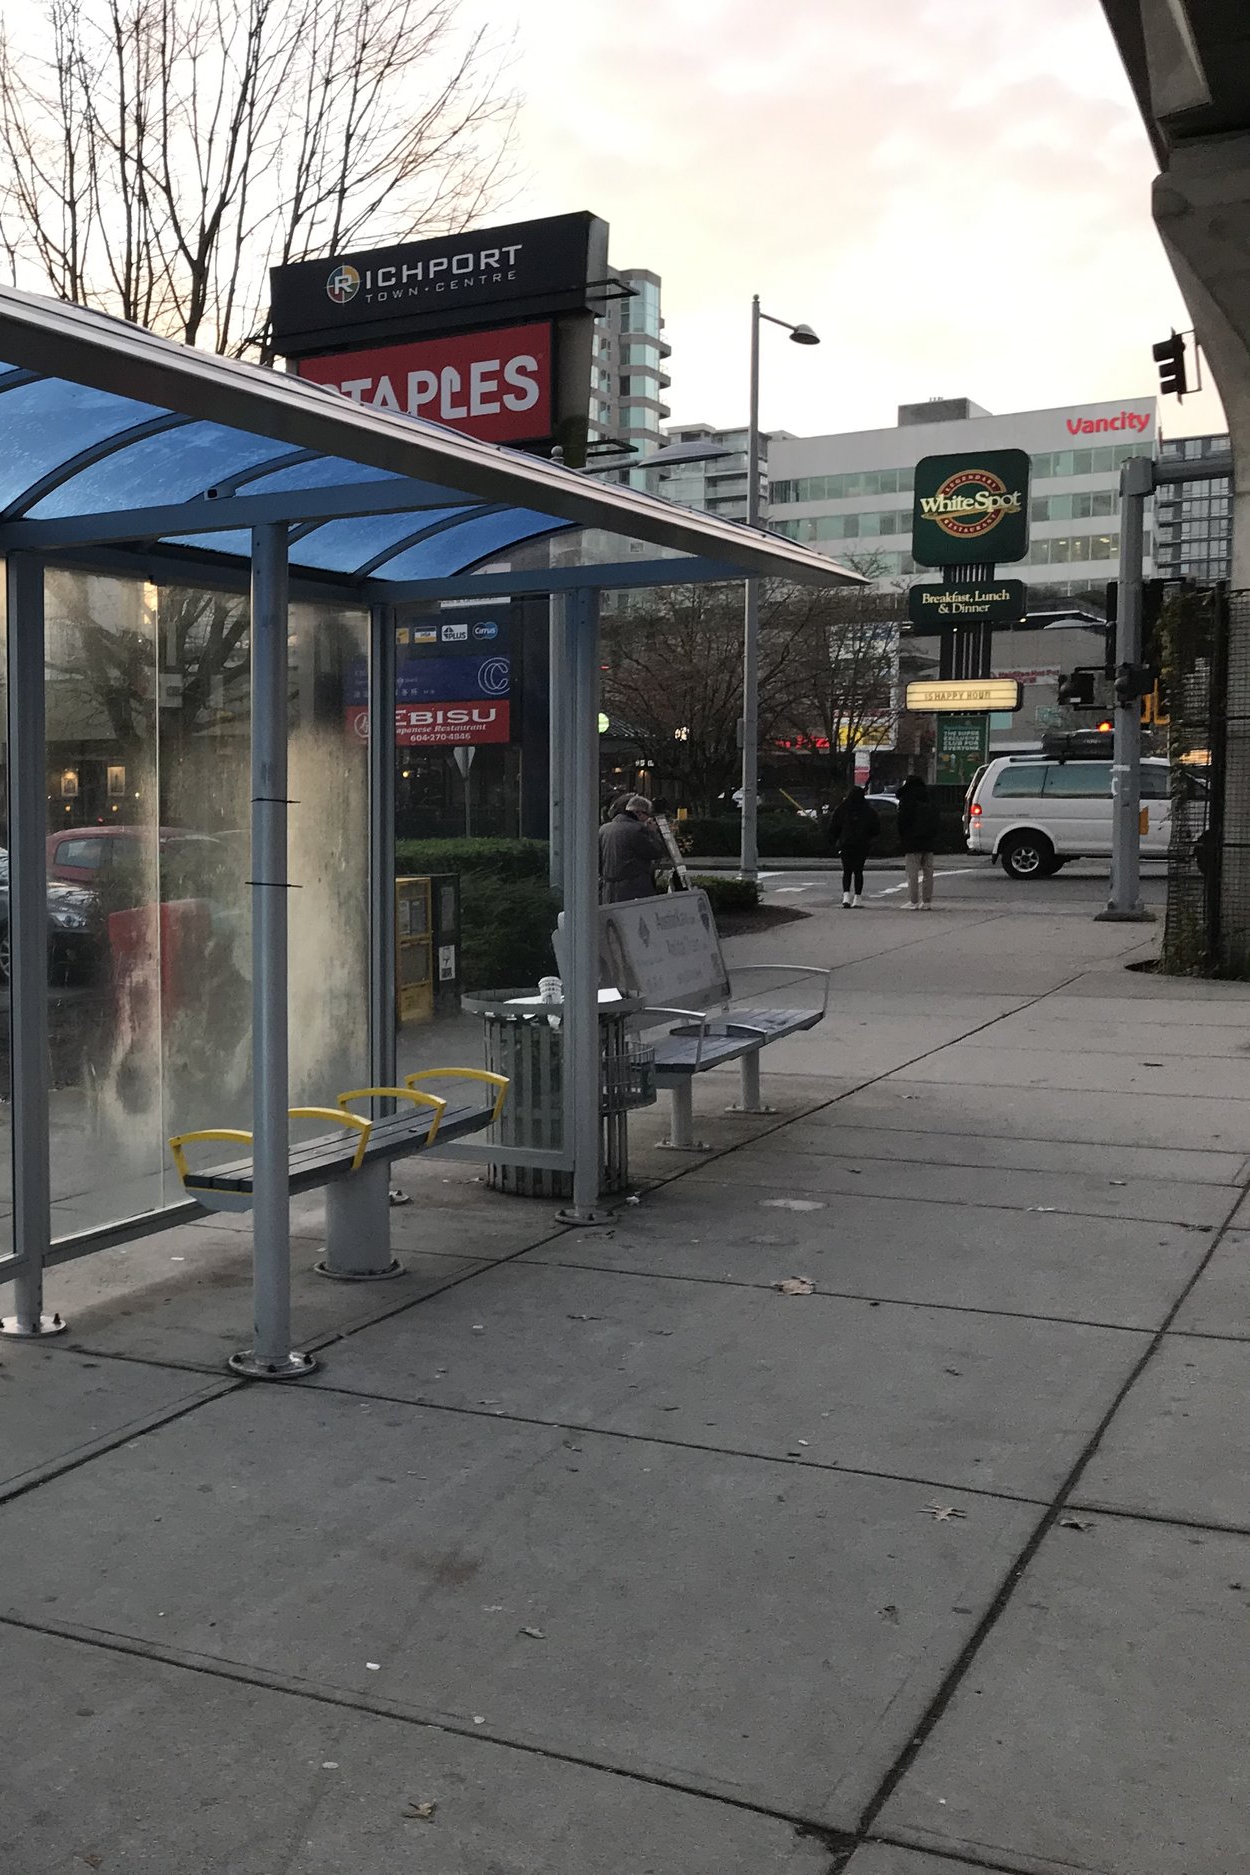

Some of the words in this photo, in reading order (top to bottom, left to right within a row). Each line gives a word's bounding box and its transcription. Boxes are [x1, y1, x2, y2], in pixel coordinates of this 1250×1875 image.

[435, 270, 517, 292] CENTRE
[320, 354, 540, 420] TAPLES
[1066, 410, 1151, 435] Vancity
[922, 591, 974, 604] Breakfast,
[975, 589, 1010, 602] Lunch
[938, 603, 949, 614] &
[951, 603, 990, 613] Dinner
[449, 631, 466, 640] PLUS
[475, 626, 496, 634] Cirrus
[396, 726, 431, 735] apanese
[434, 724, 486, 732] Restaurant
